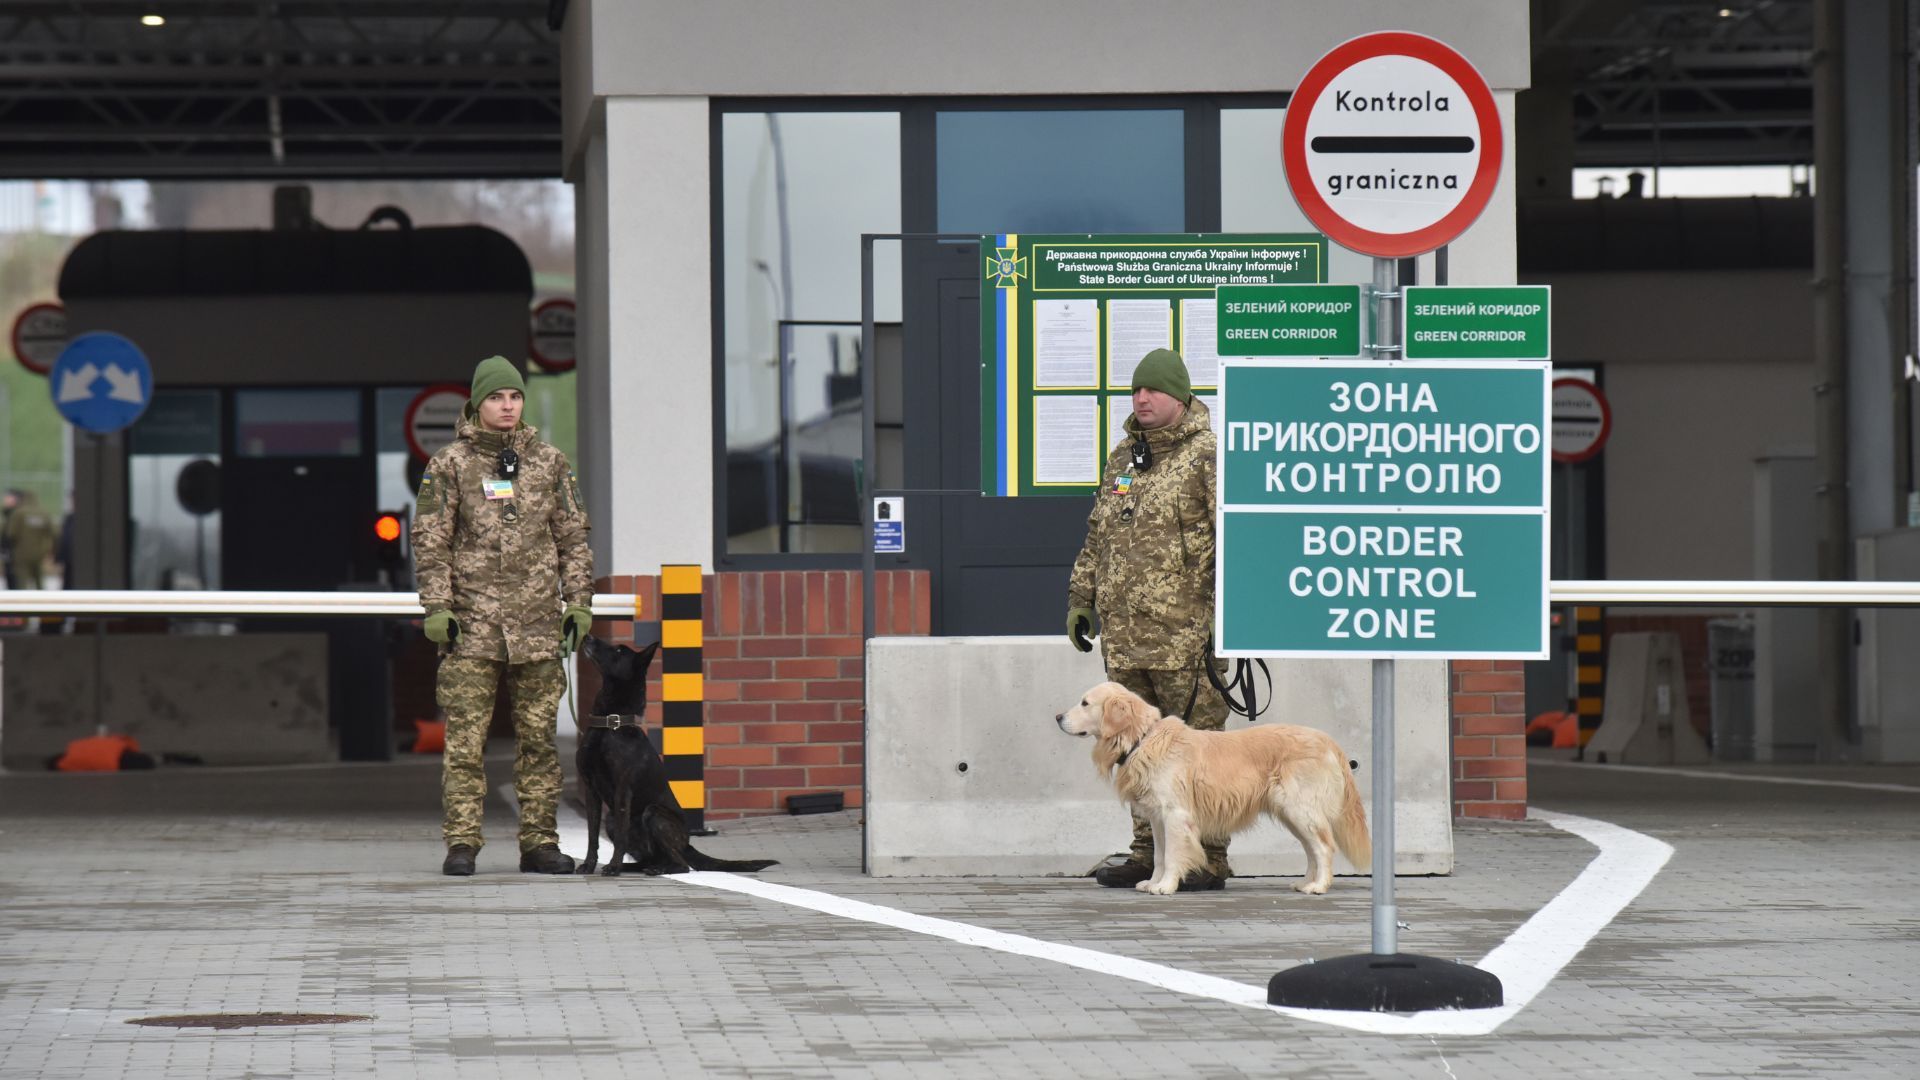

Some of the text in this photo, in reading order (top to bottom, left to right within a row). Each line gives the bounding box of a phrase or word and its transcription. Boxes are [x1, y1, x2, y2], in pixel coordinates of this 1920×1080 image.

[1336, 90, 1449, 112] Kontrola
[1328, 168, 1458, 196] graniczna
[1046, 250, 1097, 261] Державна
[1100, 251, 1167, 261] прикордонна
[1170, 250, 1207, 260] служба
[1210, 249, 1248, 260] України
[1251, 249, 1300, 260] інформує
[1057, 262, 1113, 271] Państwowa
[1116, 262, 1150, 271] Służba
[1152, 262, 1202, 271] Graniczna
[1204, 262, 1242, 273] Ukrainy
[1245, 262, 1292, 273] Informuje
[1079, 274, 1104, 284] State
[1107, 274, 1141, 284] Border
[1144, 274, 1174, 284] Guard
[1177, 274, 1187, 283] of
[1189, 274, 1227, 283] Ukraine
[1230, 274, 1267, 283] informs
[1225, 300, 1352, 315] ЗЕЛЕНИЙ КОРИДОР
[1414, 302, 1541, 317] ЗЕЛЕНИЙ КОРИДОР
[1225, 328, 1337, 339] GREEN CORRIDOR
[1414, 331, 1526, 342] GREEN CORRIDOR
[1329, 381, 1438, 413] ЗОНА
[1227, 421, 1541, 458] ПРИКОРДОННОГО
[1265, 461, 1502, 494] КОНТРОЛЮ
[1303, 525, 1464, 557] BORDER
[1288, 566, 1477, 598] CONTROL
[1327, 608, 1436, 639] ZONE
